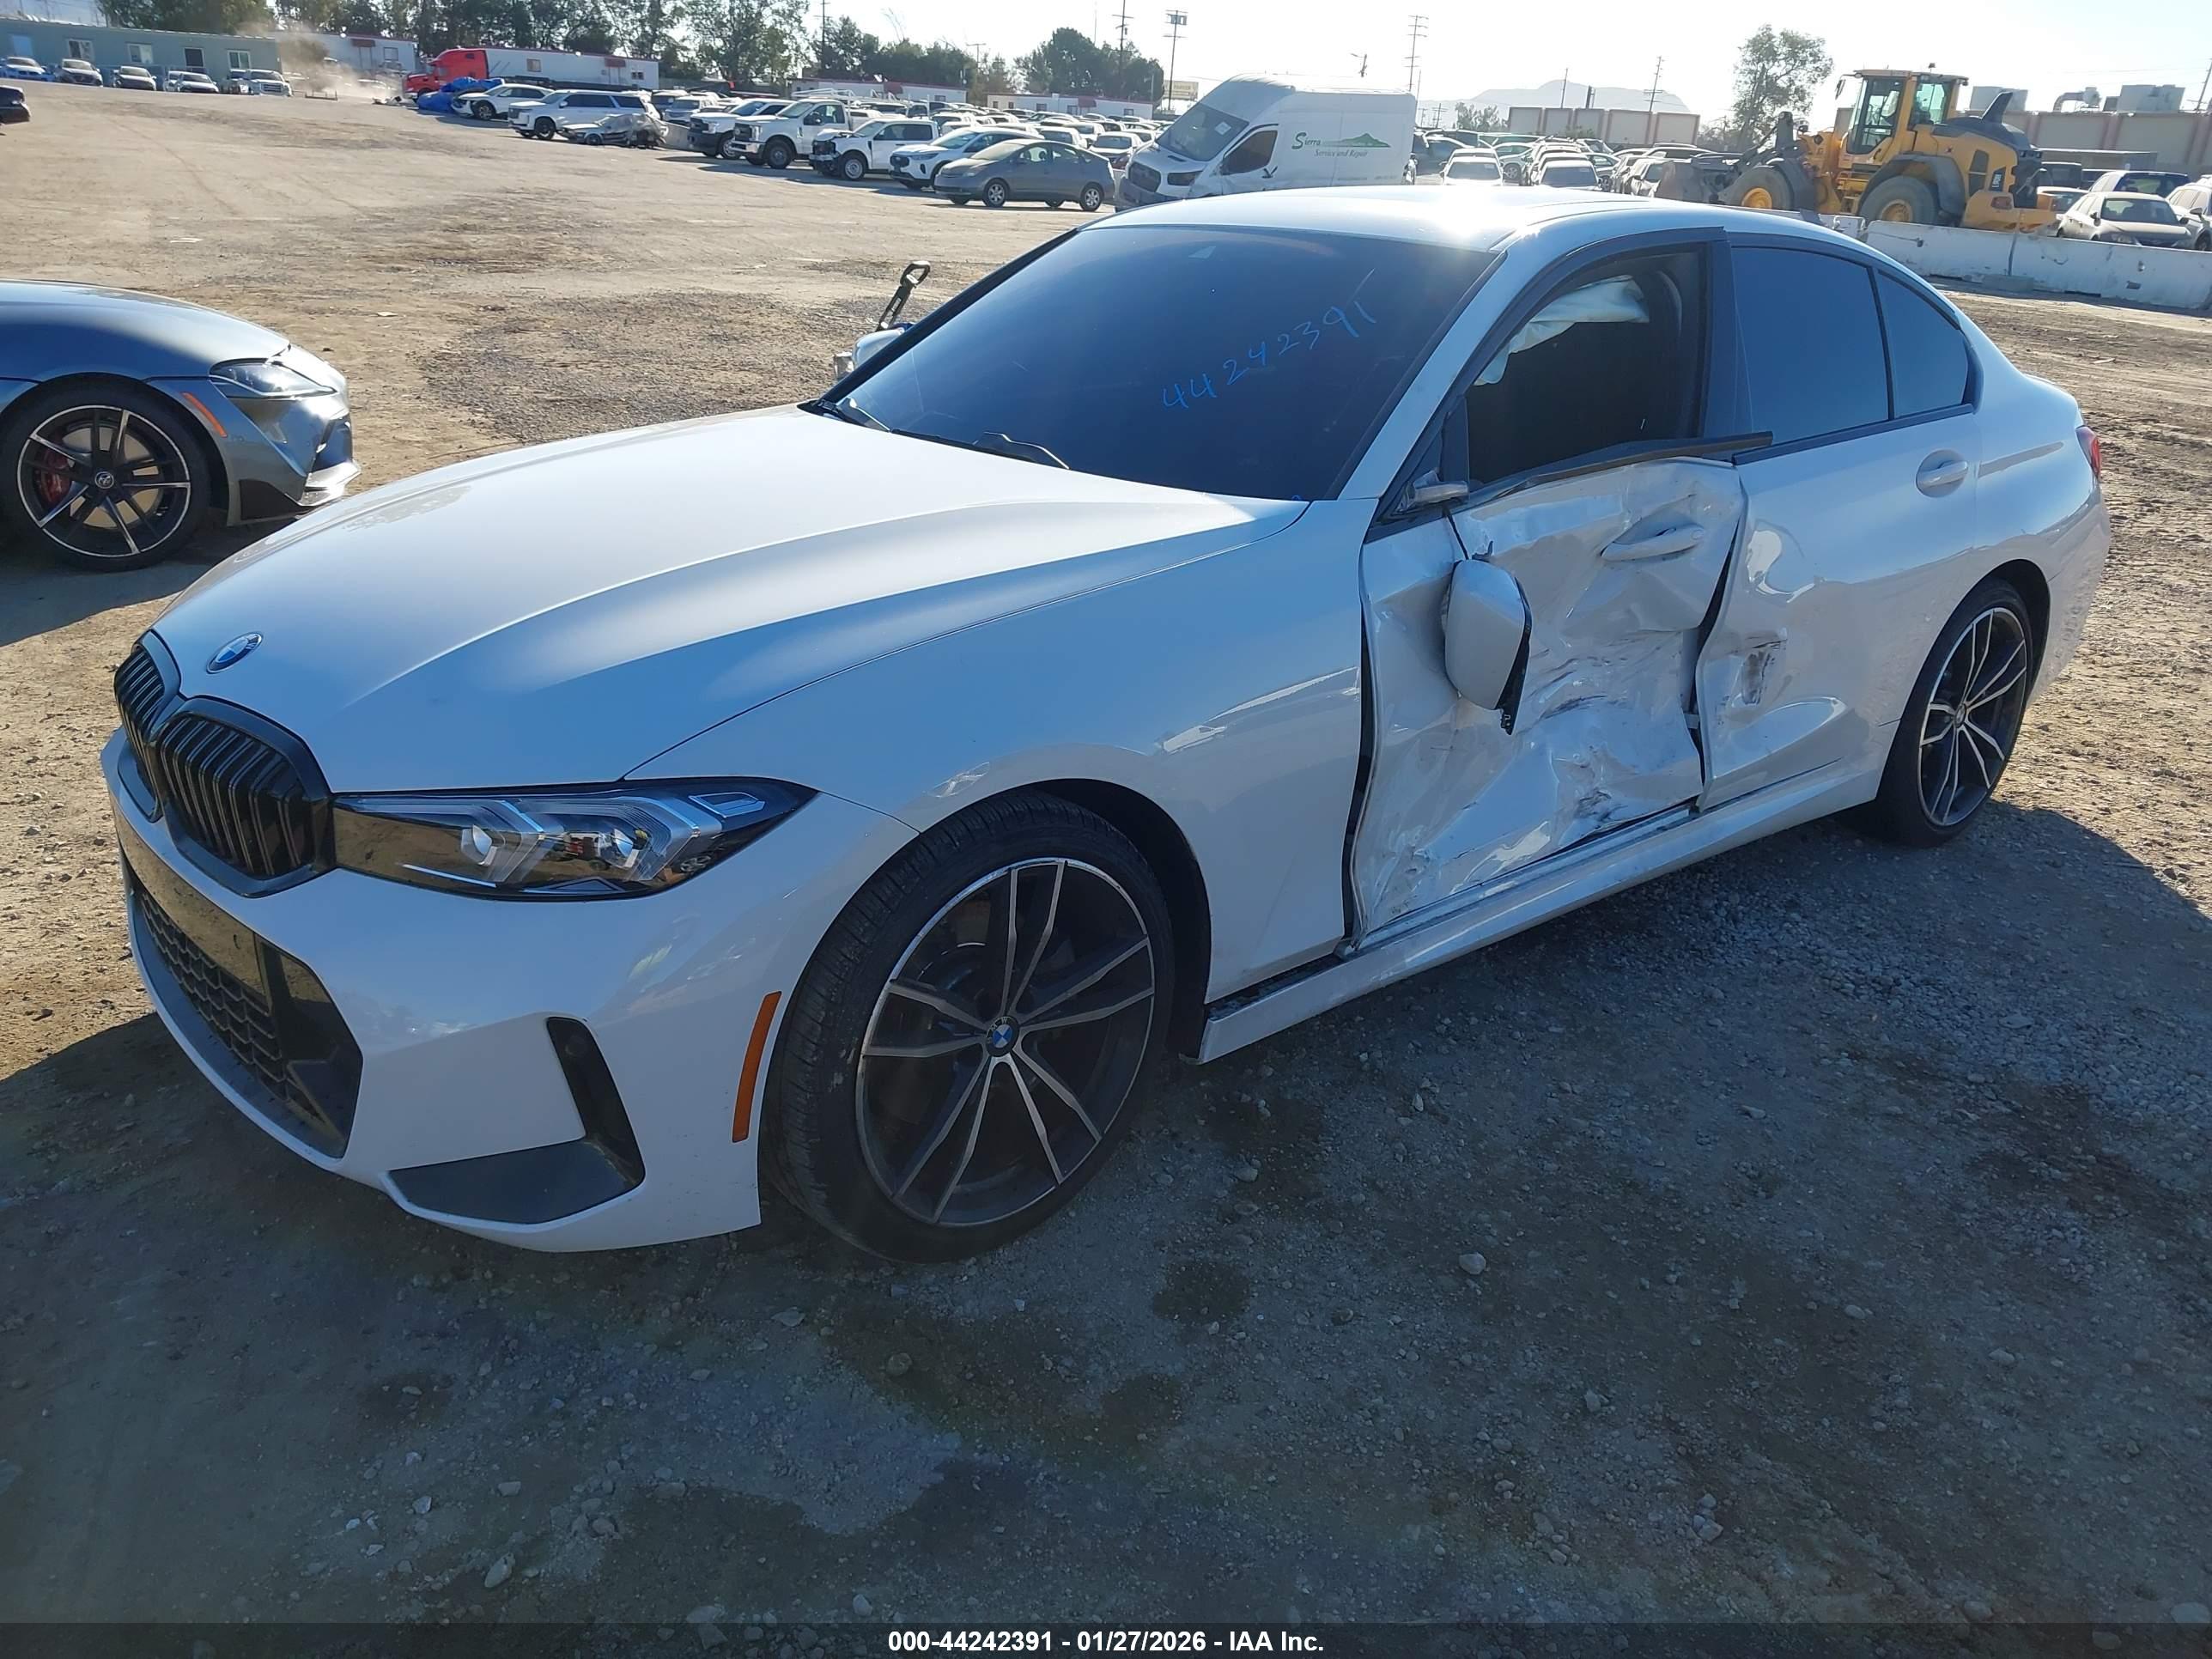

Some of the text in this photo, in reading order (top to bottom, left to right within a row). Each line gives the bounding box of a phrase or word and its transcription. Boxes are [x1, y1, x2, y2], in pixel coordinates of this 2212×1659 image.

[1291, 132, 1322, 149] Sierra
[1314, 149, 1335, 157] Service
[1336, 149, 1349, 157] and
[1162, 301, 1377, 409] 44242391
